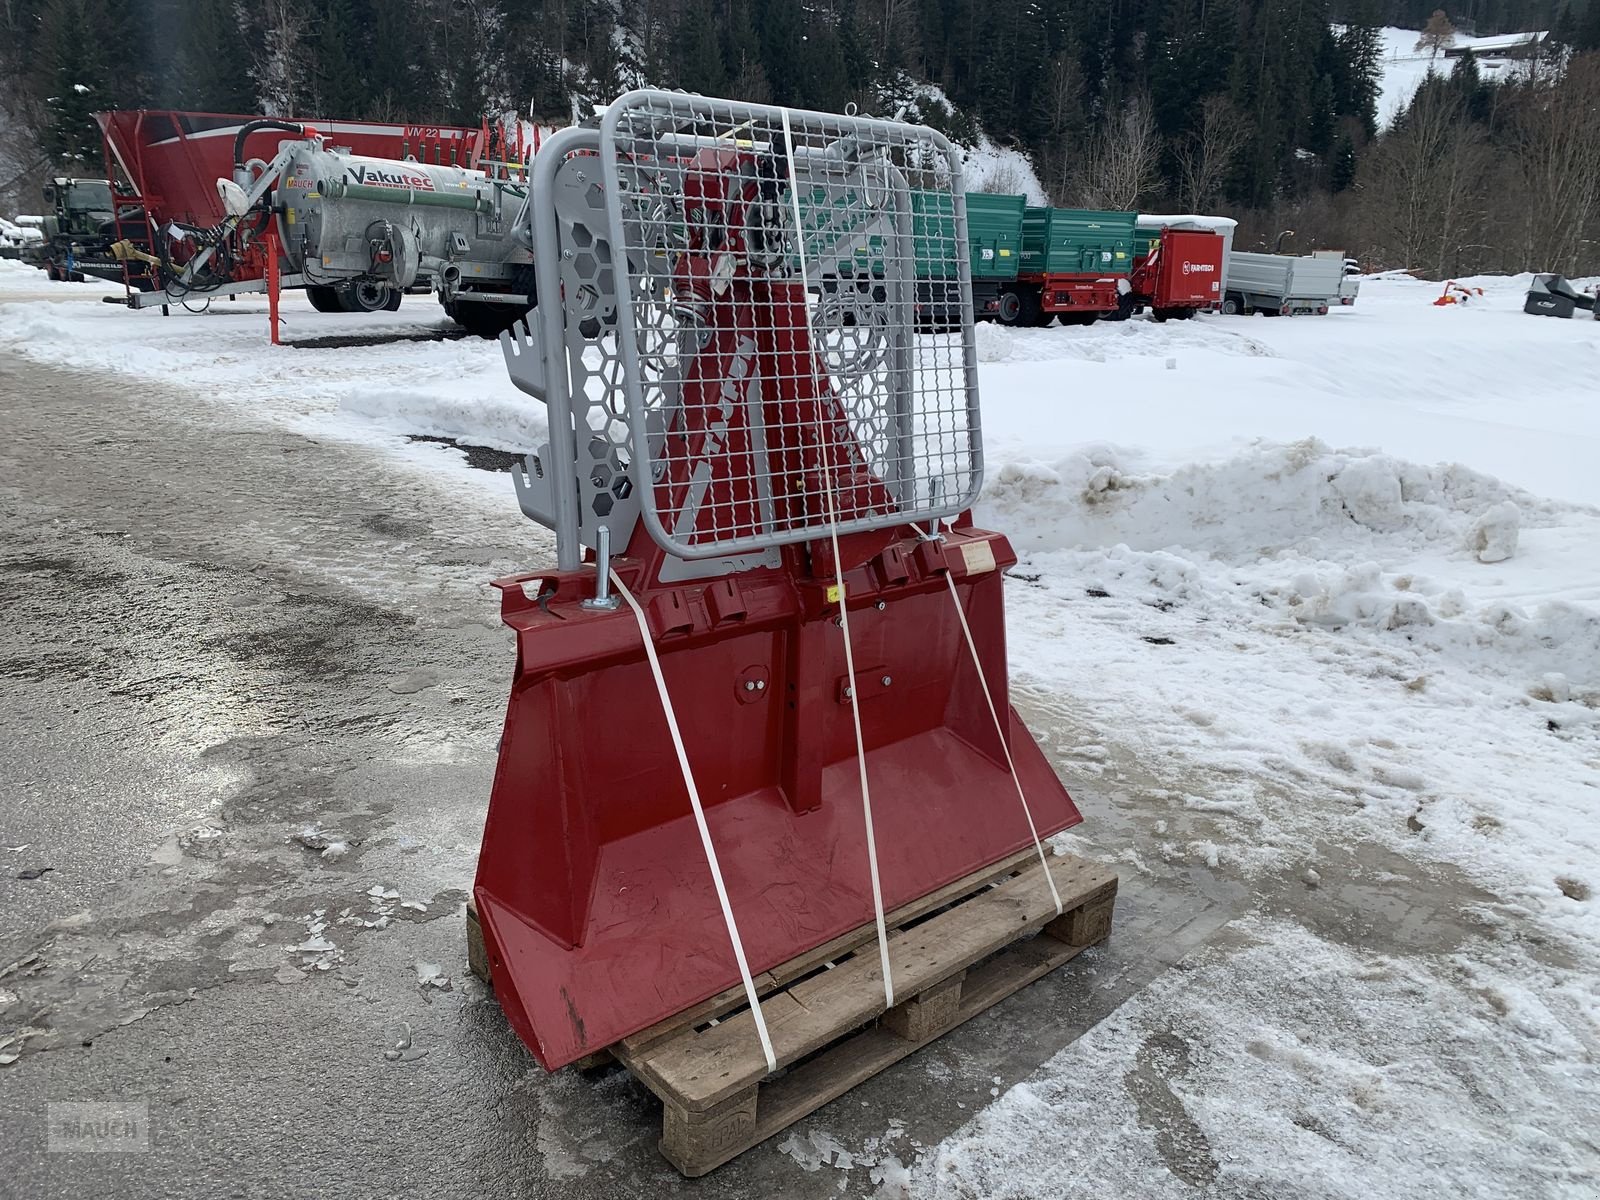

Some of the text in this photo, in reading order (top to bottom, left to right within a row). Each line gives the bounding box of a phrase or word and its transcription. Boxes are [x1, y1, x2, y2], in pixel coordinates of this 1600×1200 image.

[425, 128, 438, 138] 22
[347, 165, 434, 188] Vakutec
[287, 179, 314, 189] MAUCH
